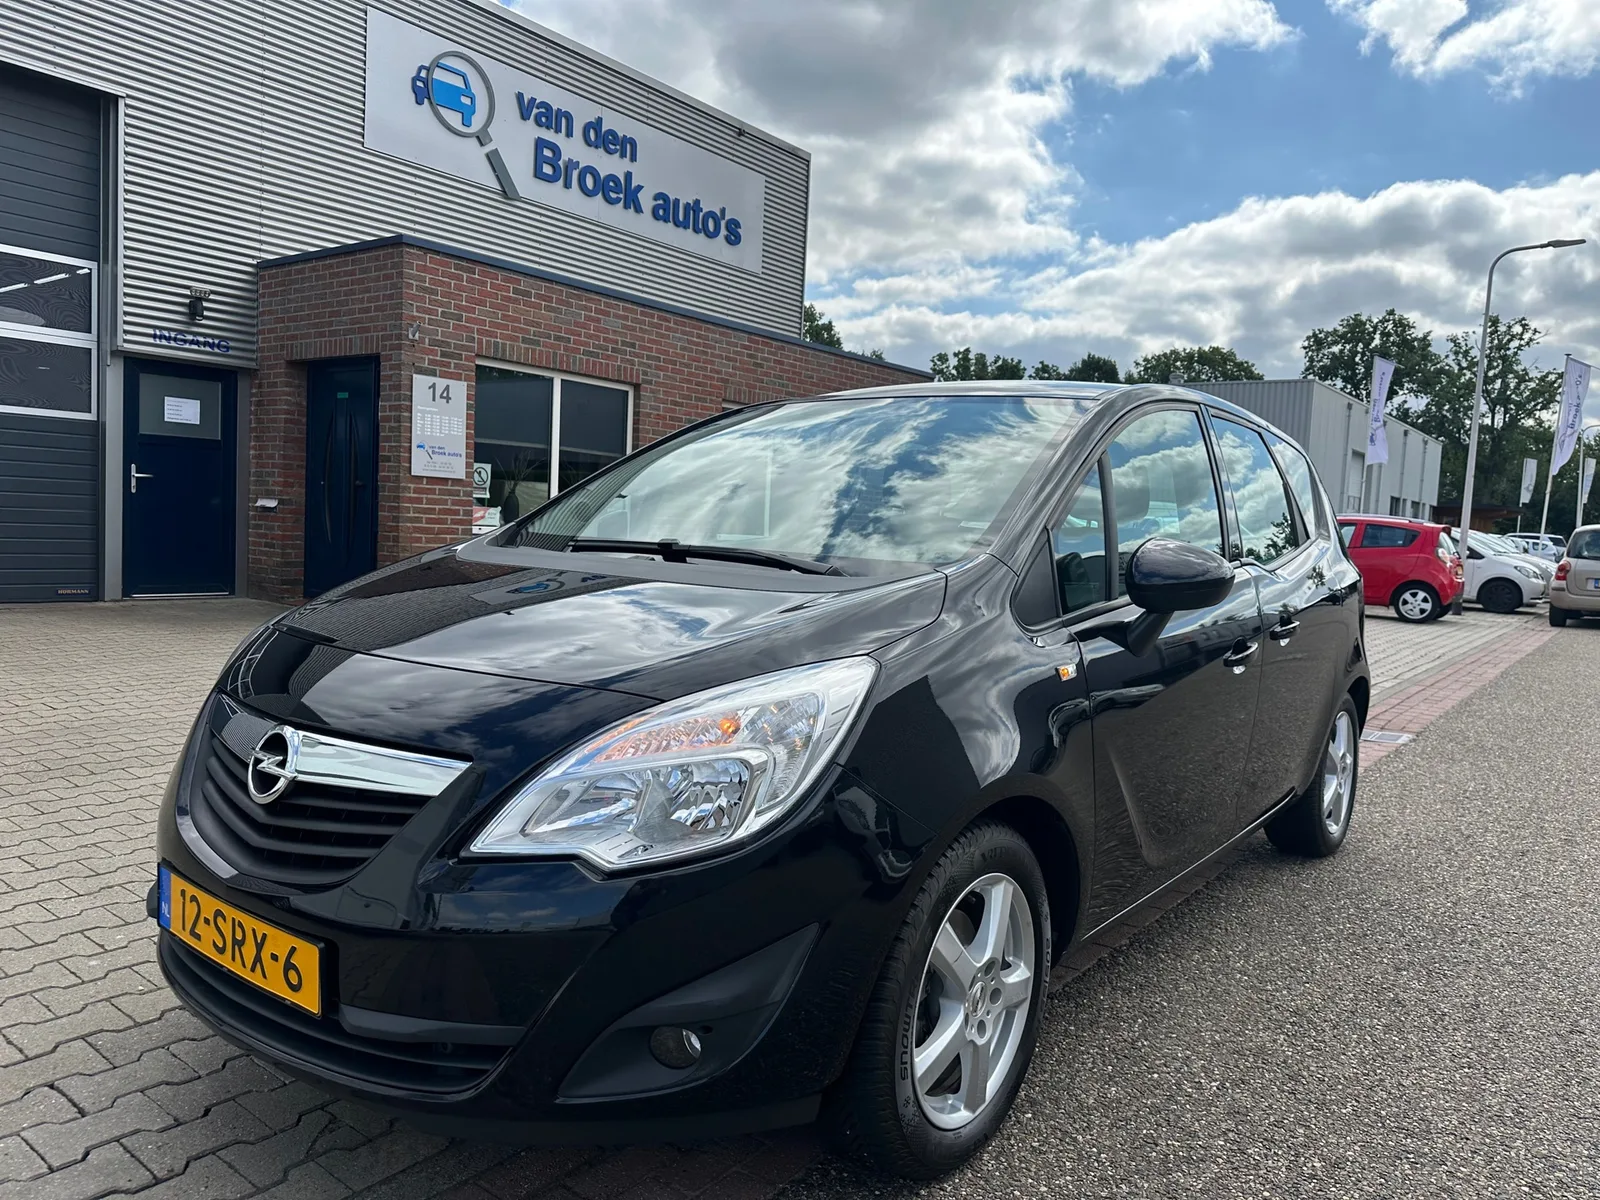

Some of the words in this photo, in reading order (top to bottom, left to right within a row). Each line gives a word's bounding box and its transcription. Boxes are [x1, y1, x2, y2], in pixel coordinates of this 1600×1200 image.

[516, 91, 574, 138] van
[583, 116, 638, 163] den
[534, 136, 645, 215] Broek
[652, 191, 742, 247] auto's
[152, 328, 231, 353] INGANG
[428, 382, 452, 404] 14
[161, 901, 170, 918] NL
[180, 889, 303, 993] 12-SRX-6
